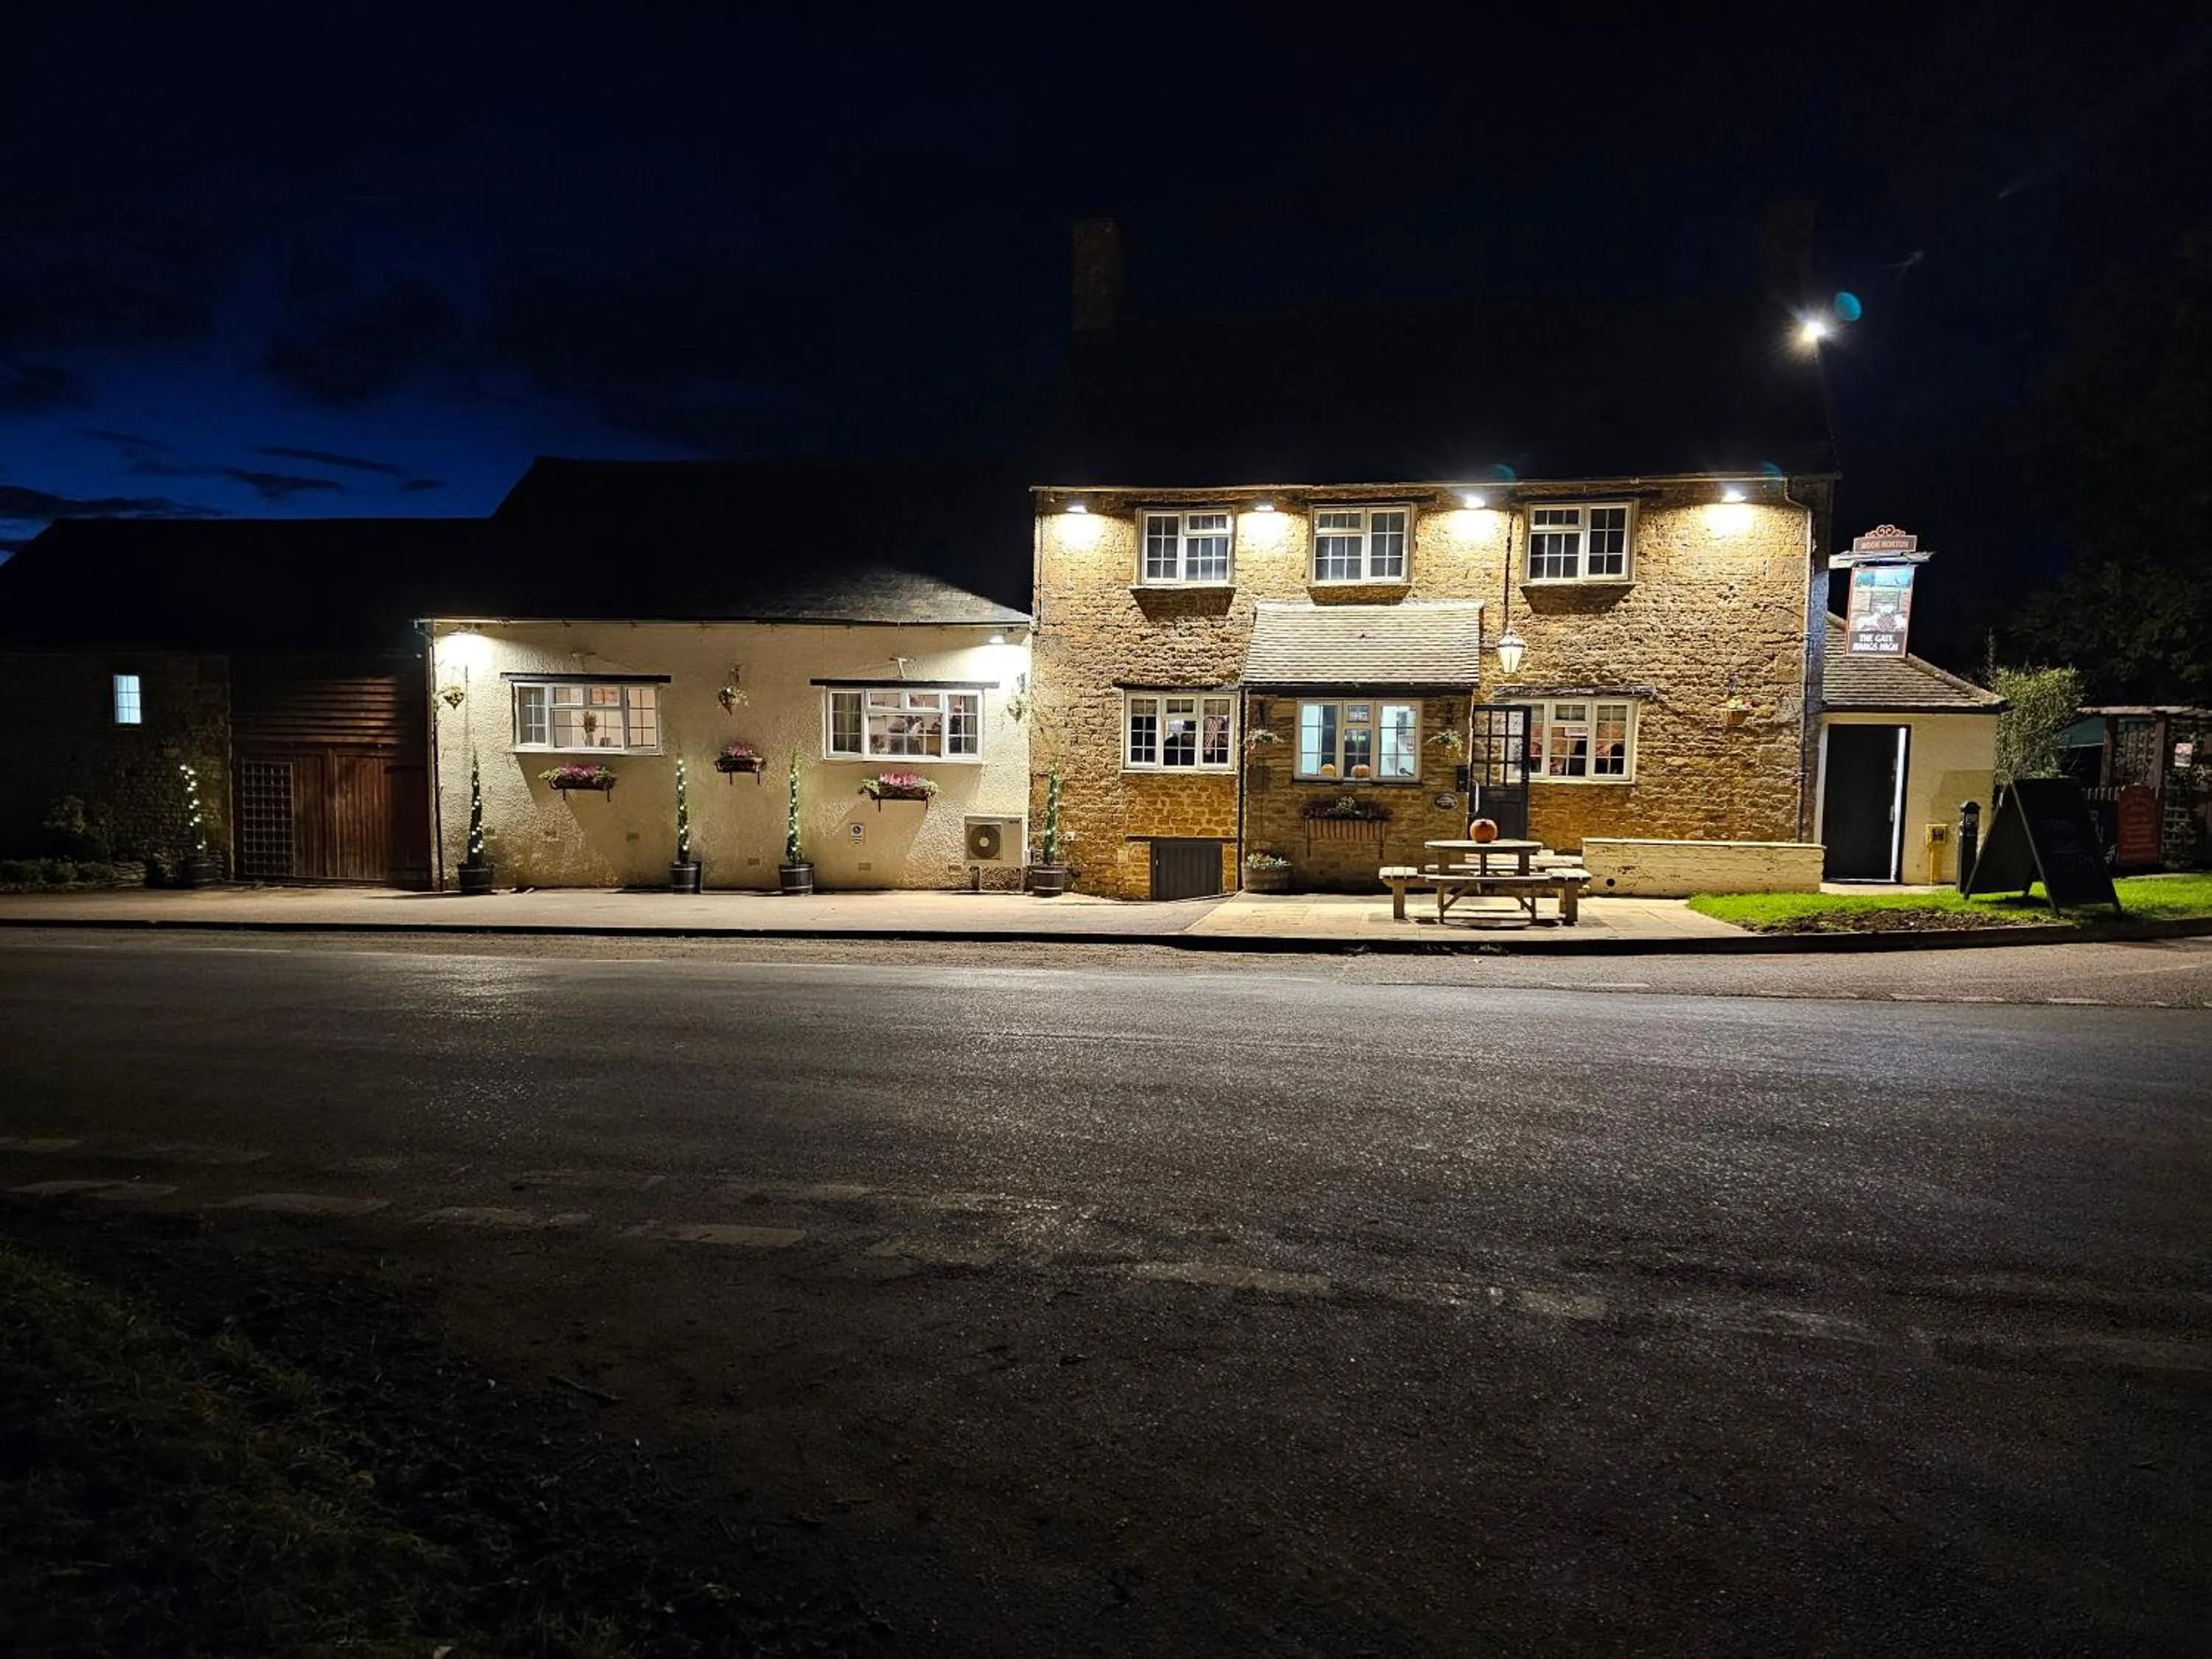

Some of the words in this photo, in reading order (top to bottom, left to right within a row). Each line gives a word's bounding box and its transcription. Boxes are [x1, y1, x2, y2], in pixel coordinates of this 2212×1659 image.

[1858, 633, 1874, 642] THE
[1874, 633, 1893, 642] GATE
[1852, 642, 1878, 651] HANGS
[1879, 642, 1899, 651] HIGH
